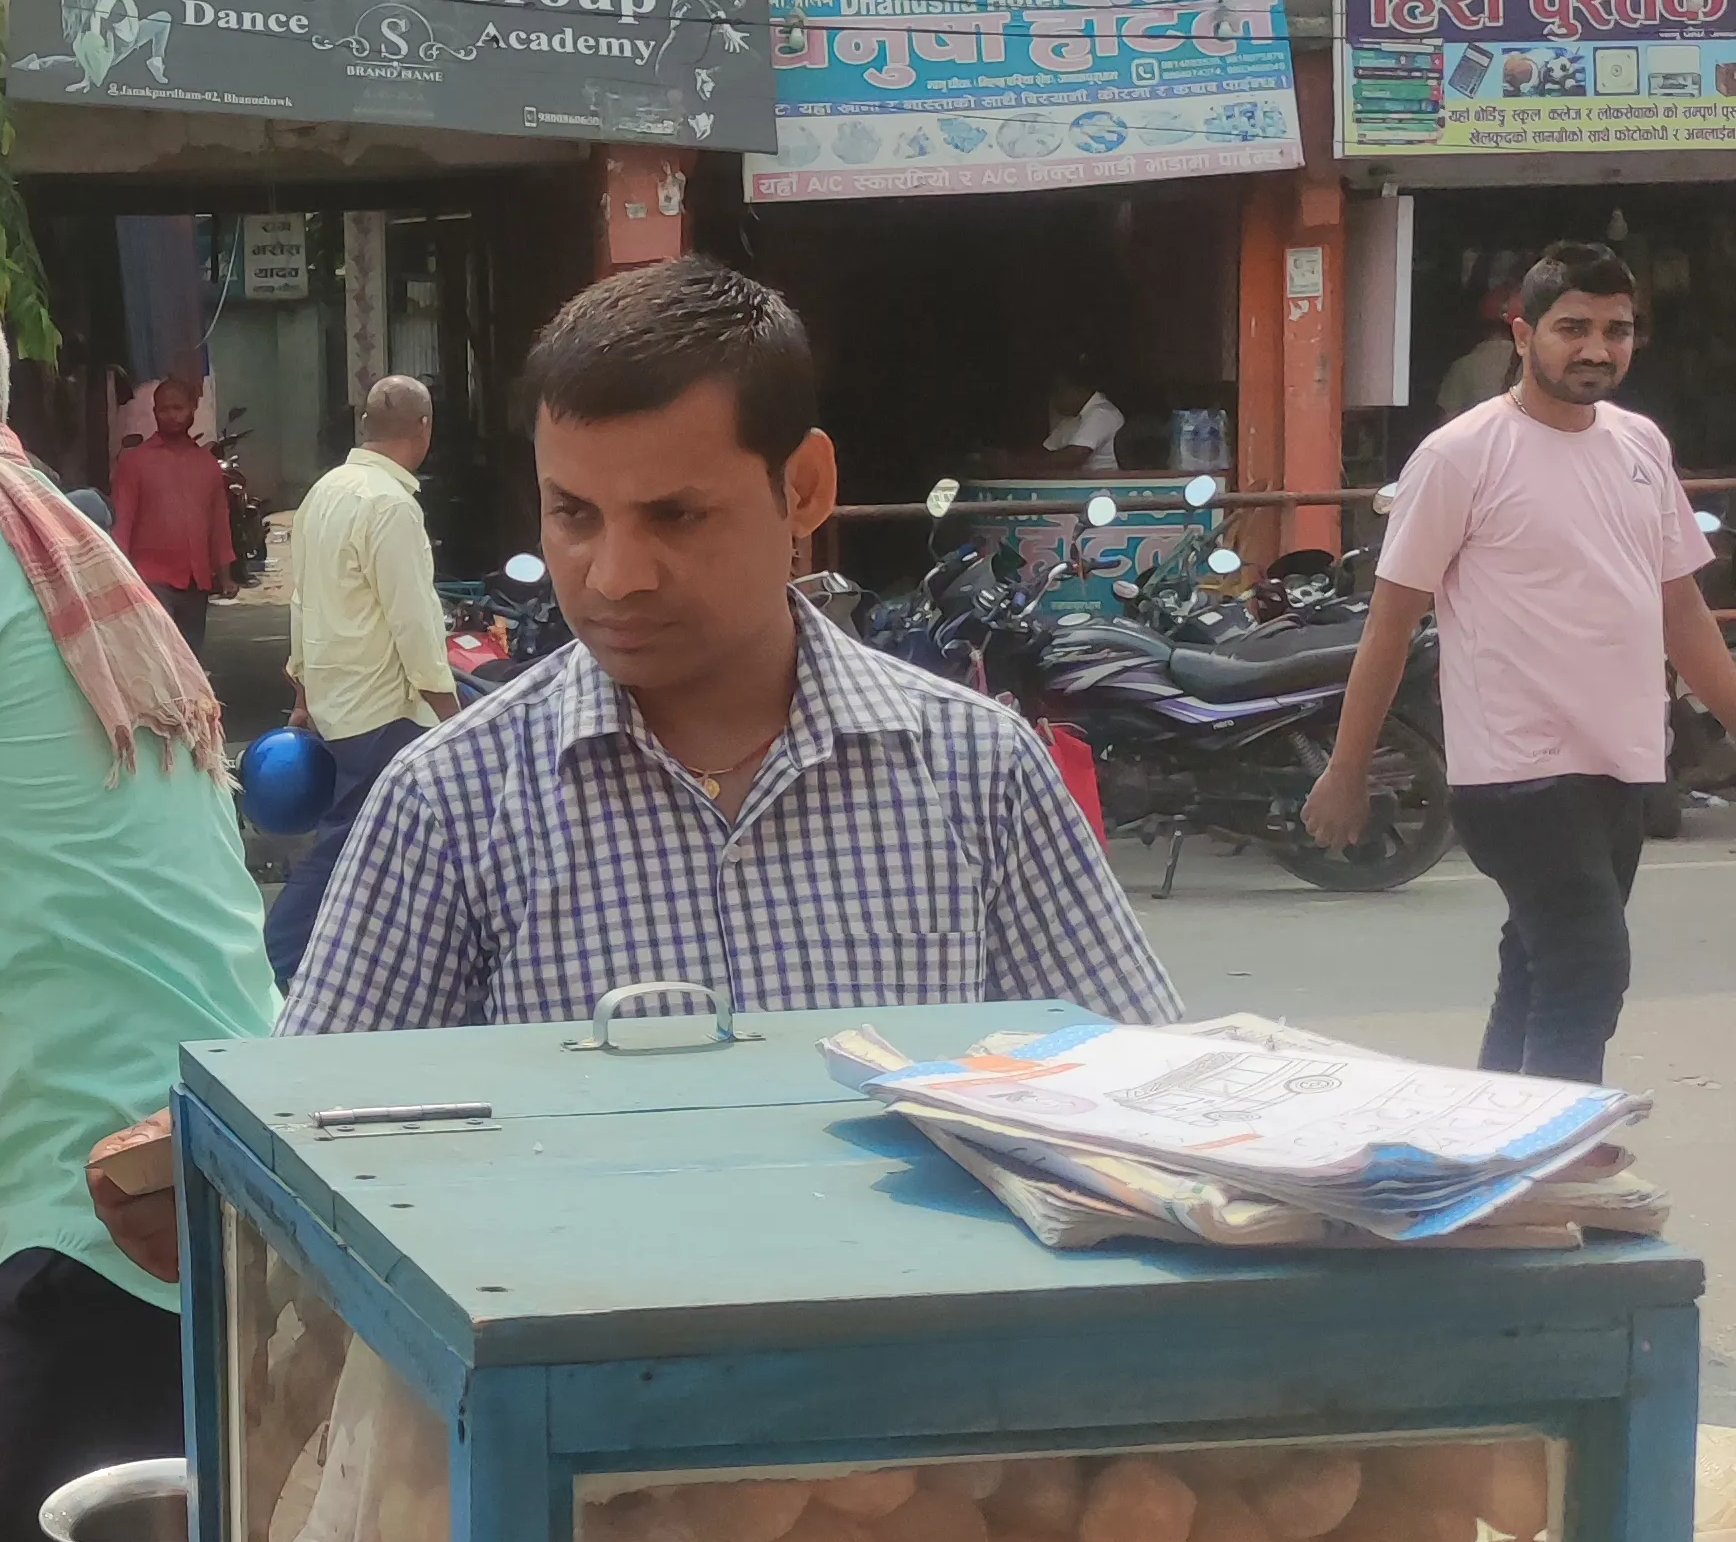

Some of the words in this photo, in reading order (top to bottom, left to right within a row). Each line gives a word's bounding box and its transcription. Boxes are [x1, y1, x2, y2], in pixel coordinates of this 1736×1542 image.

[475, 20, 657, 65] Academy
[346, 64, 398, 78] BRAND
[401, 69, 443, 83] NAME
[807, 175, 843, 194] A/C
[981, 167, 1018, 186] A/C
